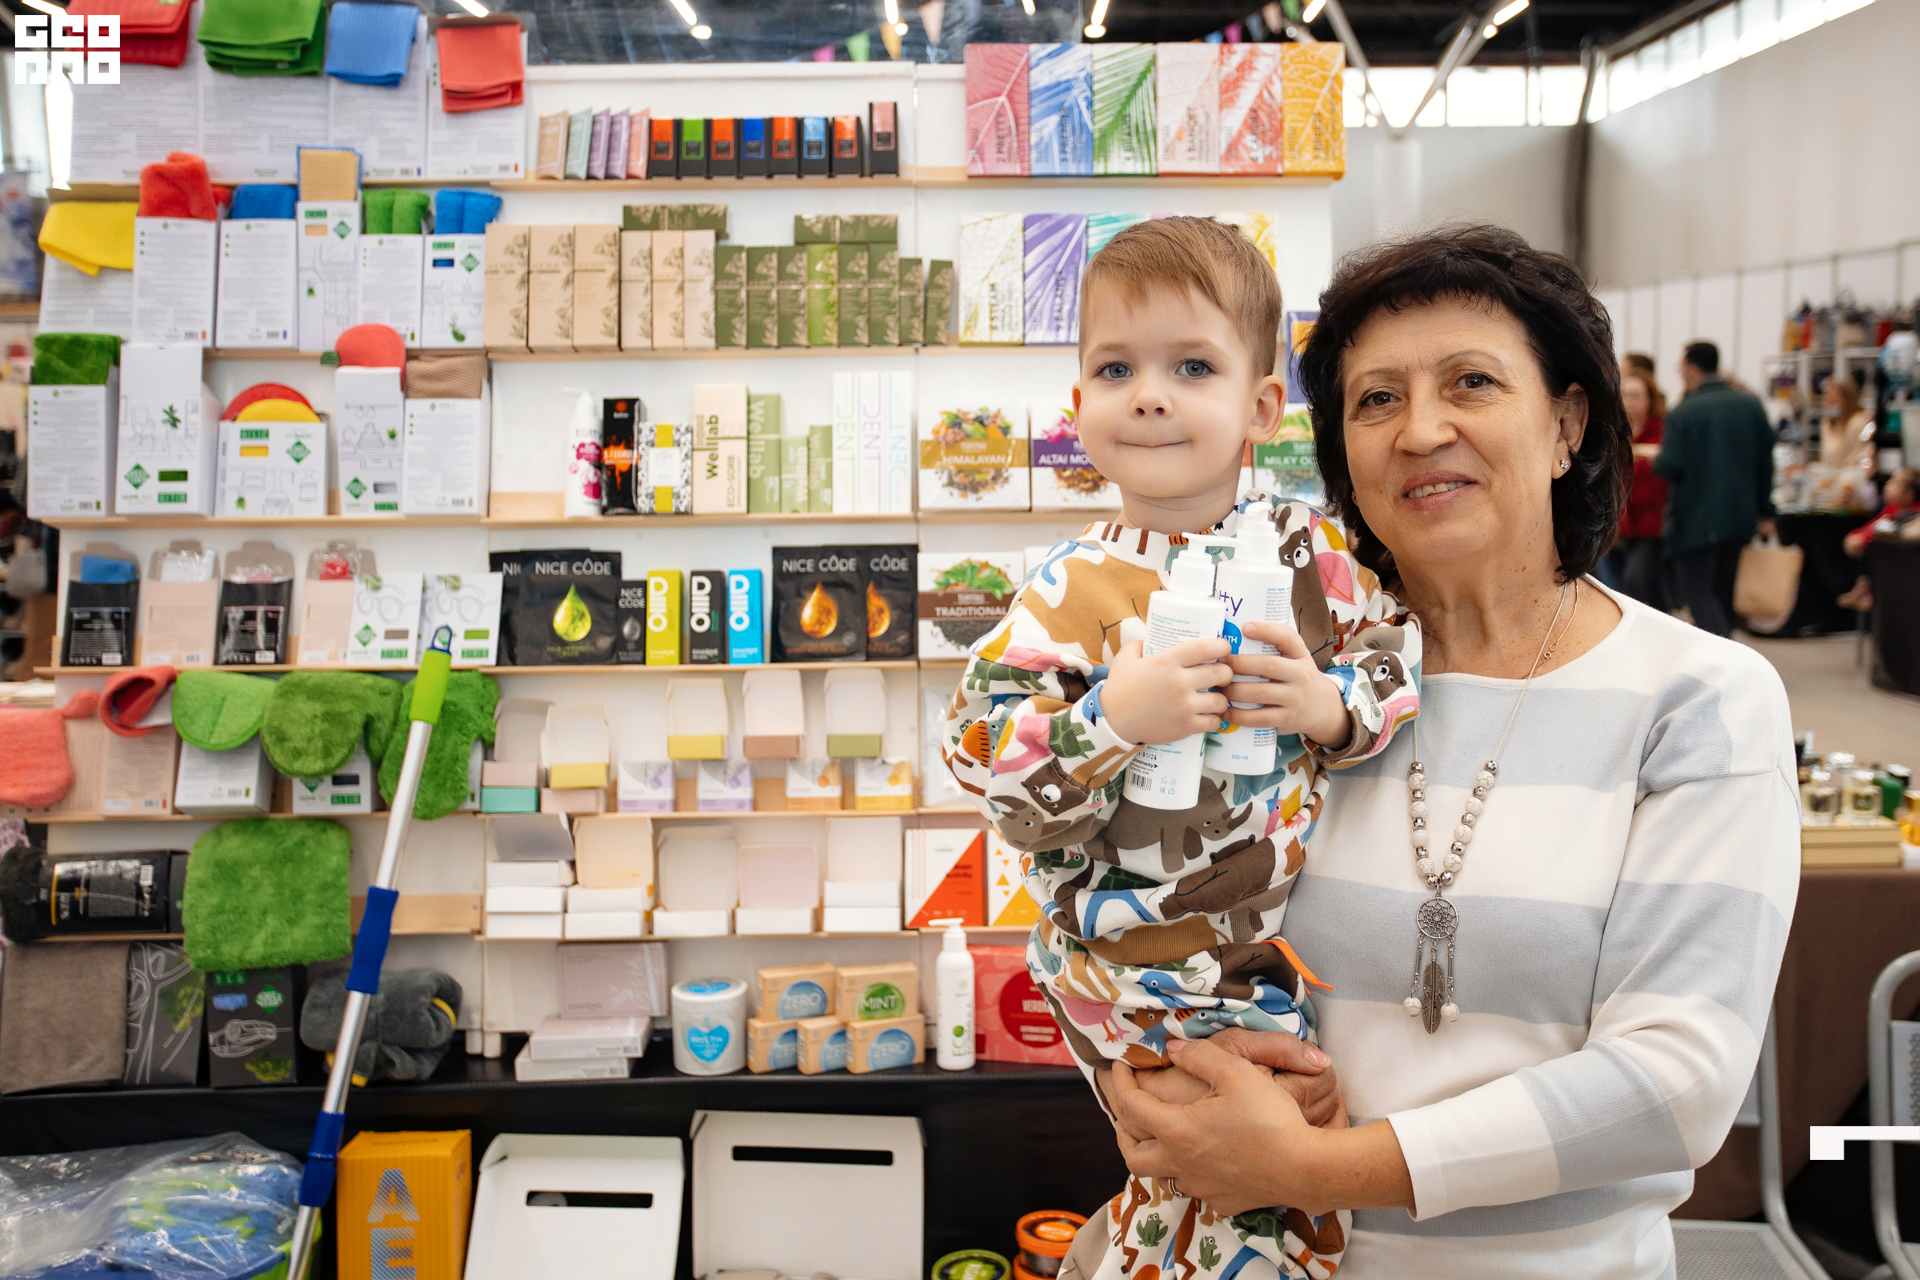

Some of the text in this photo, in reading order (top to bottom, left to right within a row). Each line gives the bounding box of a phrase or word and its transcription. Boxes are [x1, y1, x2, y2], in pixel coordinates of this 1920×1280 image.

[943, 454, 1006, 465] HIMALAYAN
[1038, 454, 1068, 465] ALTAI
[1264, 456, 1297, 465] MILKY
[535, 557, 611, 575] NICE CODE
[782, 554, 857, 572] NICE CODE
[870, 554, 909, 572] CODE
[621, 588, 643, 599] NICE
[618, 597, 645, 608] CODE
[935, 606, 1007, 617] TRADITIONAL
[861, 995, 898, 1010] MINT
